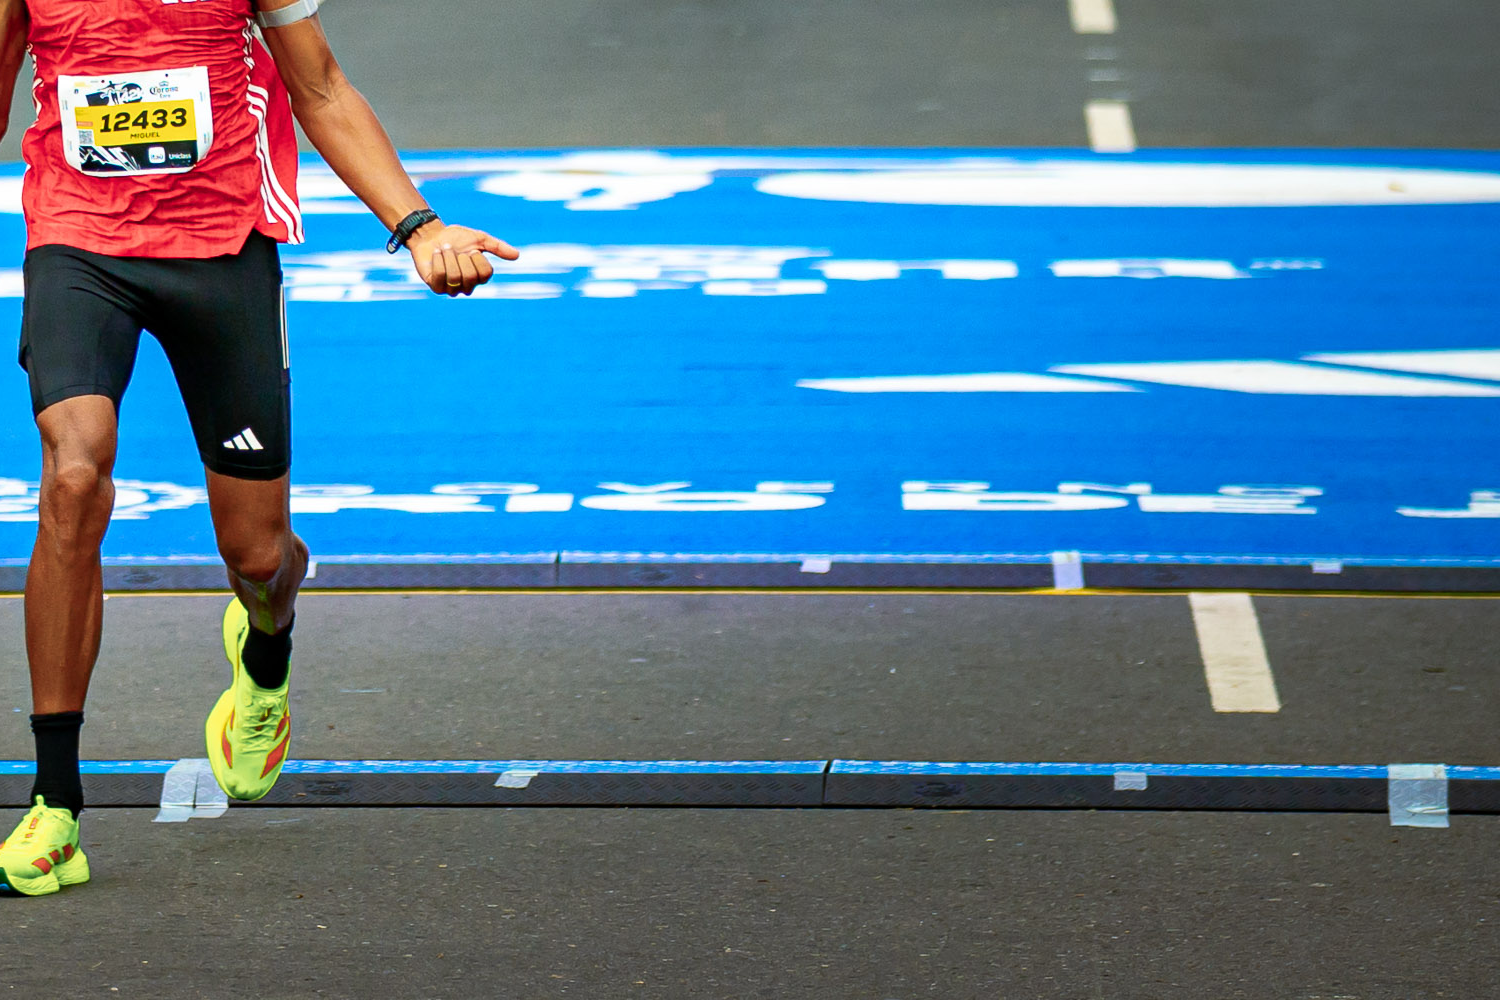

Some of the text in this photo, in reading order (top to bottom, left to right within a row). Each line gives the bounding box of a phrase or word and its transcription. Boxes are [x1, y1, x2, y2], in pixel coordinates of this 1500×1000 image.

[100, 107, 187, 133] 12433
[130, 131, 161, 139] MIGUEL
[901, 491, 1318, 514] DE
